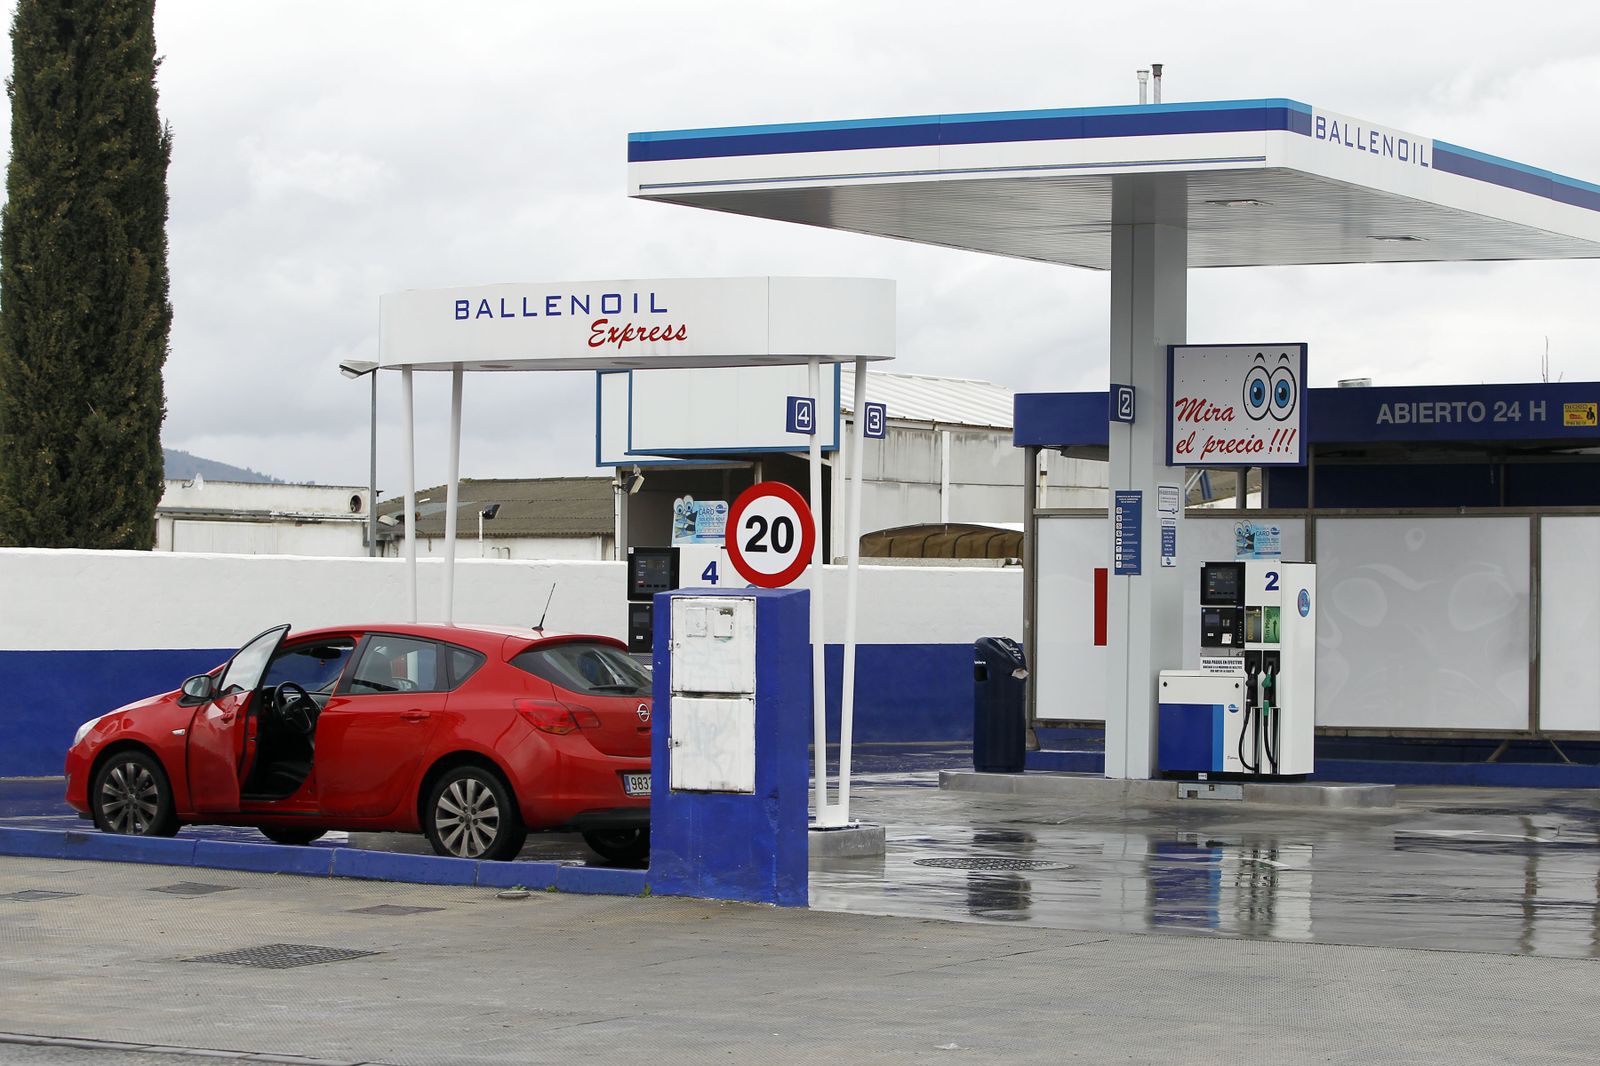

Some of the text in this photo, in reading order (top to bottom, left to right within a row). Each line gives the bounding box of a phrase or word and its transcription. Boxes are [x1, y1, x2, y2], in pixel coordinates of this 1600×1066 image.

[1316, 115, 1429, 167] BALLENOIL
[455, 292, 668, 320] BALLENOIL
[588, 318, 688, 349] Express
[798, 406, 810, 425] 4
[1121, 394, 1131, 413] 2
[1175, 397, 1235, 423] Mira
[1376, 400, 1546, 424] ABIERTO 24 H
[869, 411, 880, 429] 3
[1176, 431, 1195, 454] el
[745, 515, 794, 554] 20
[701, 561, 719, 585] 4
[1265, 571, 1280, 591] 2
